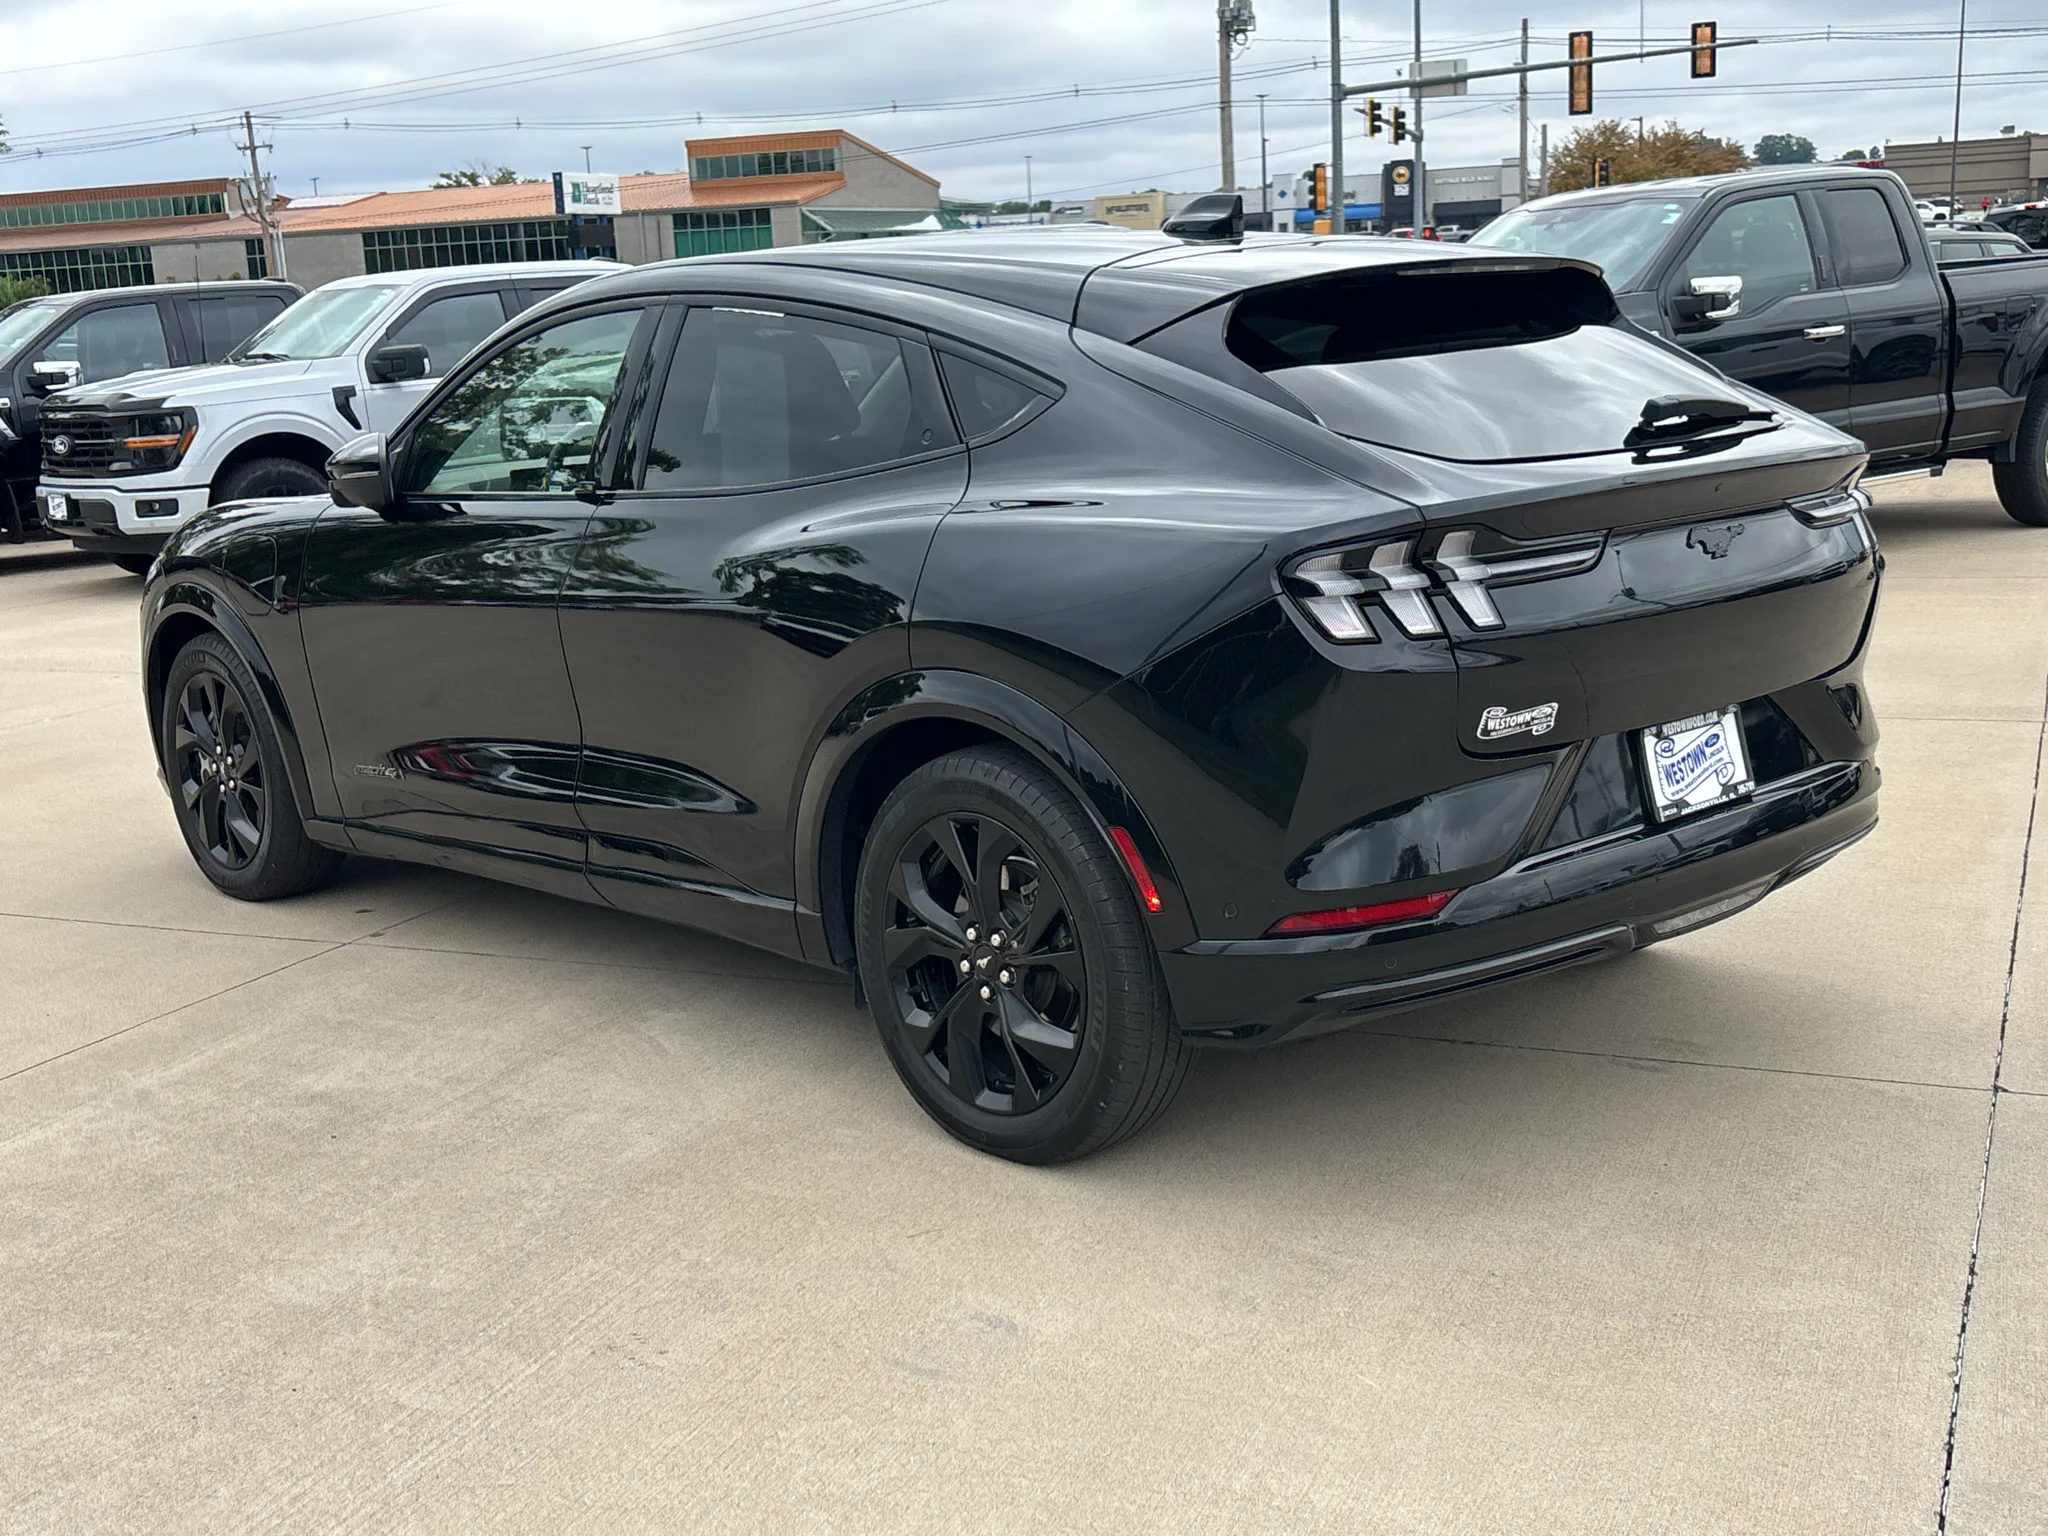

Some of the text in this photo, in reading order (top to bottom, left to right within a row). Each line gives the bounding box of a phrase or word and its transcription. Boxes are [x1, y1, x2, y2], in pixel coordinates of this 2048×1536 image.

[583, 194, 601, 205] Bank
[1487, 711, 1532, 730] WESTOWN
[1661, 710, 1718, 736] WESTOWNFORD.COM
[1706, 735, 1719, 746] Ford
[1707, 746, 1724, 760] LINCOLN
[1662, 741, 1708, 788] WESTOWN
[1671, 757, 1724, 797] www.westownford.com
